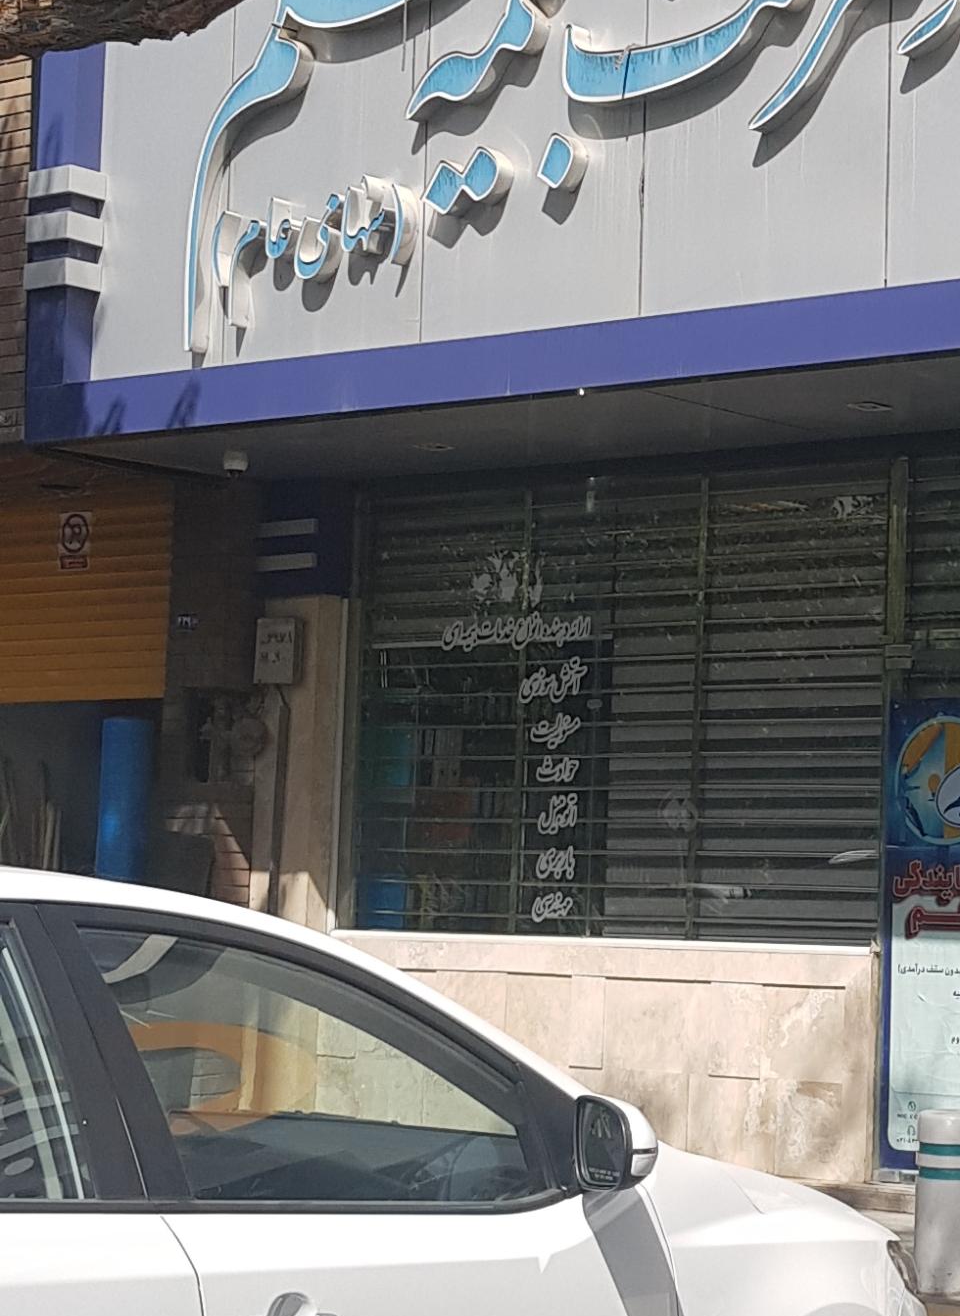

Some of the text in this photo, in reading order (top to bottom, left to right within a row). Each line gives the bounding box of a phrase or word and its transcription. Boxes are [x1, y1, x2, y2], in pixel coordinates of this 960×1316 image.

[529, 712, 581, 750] مسئولیت
[535, 755, 580, 783] حوادث
[537, 792, 578, 835] اتومبیل
[535, 845, 576, 881] باربری
[531, 891, 574, 923] مهندسی
